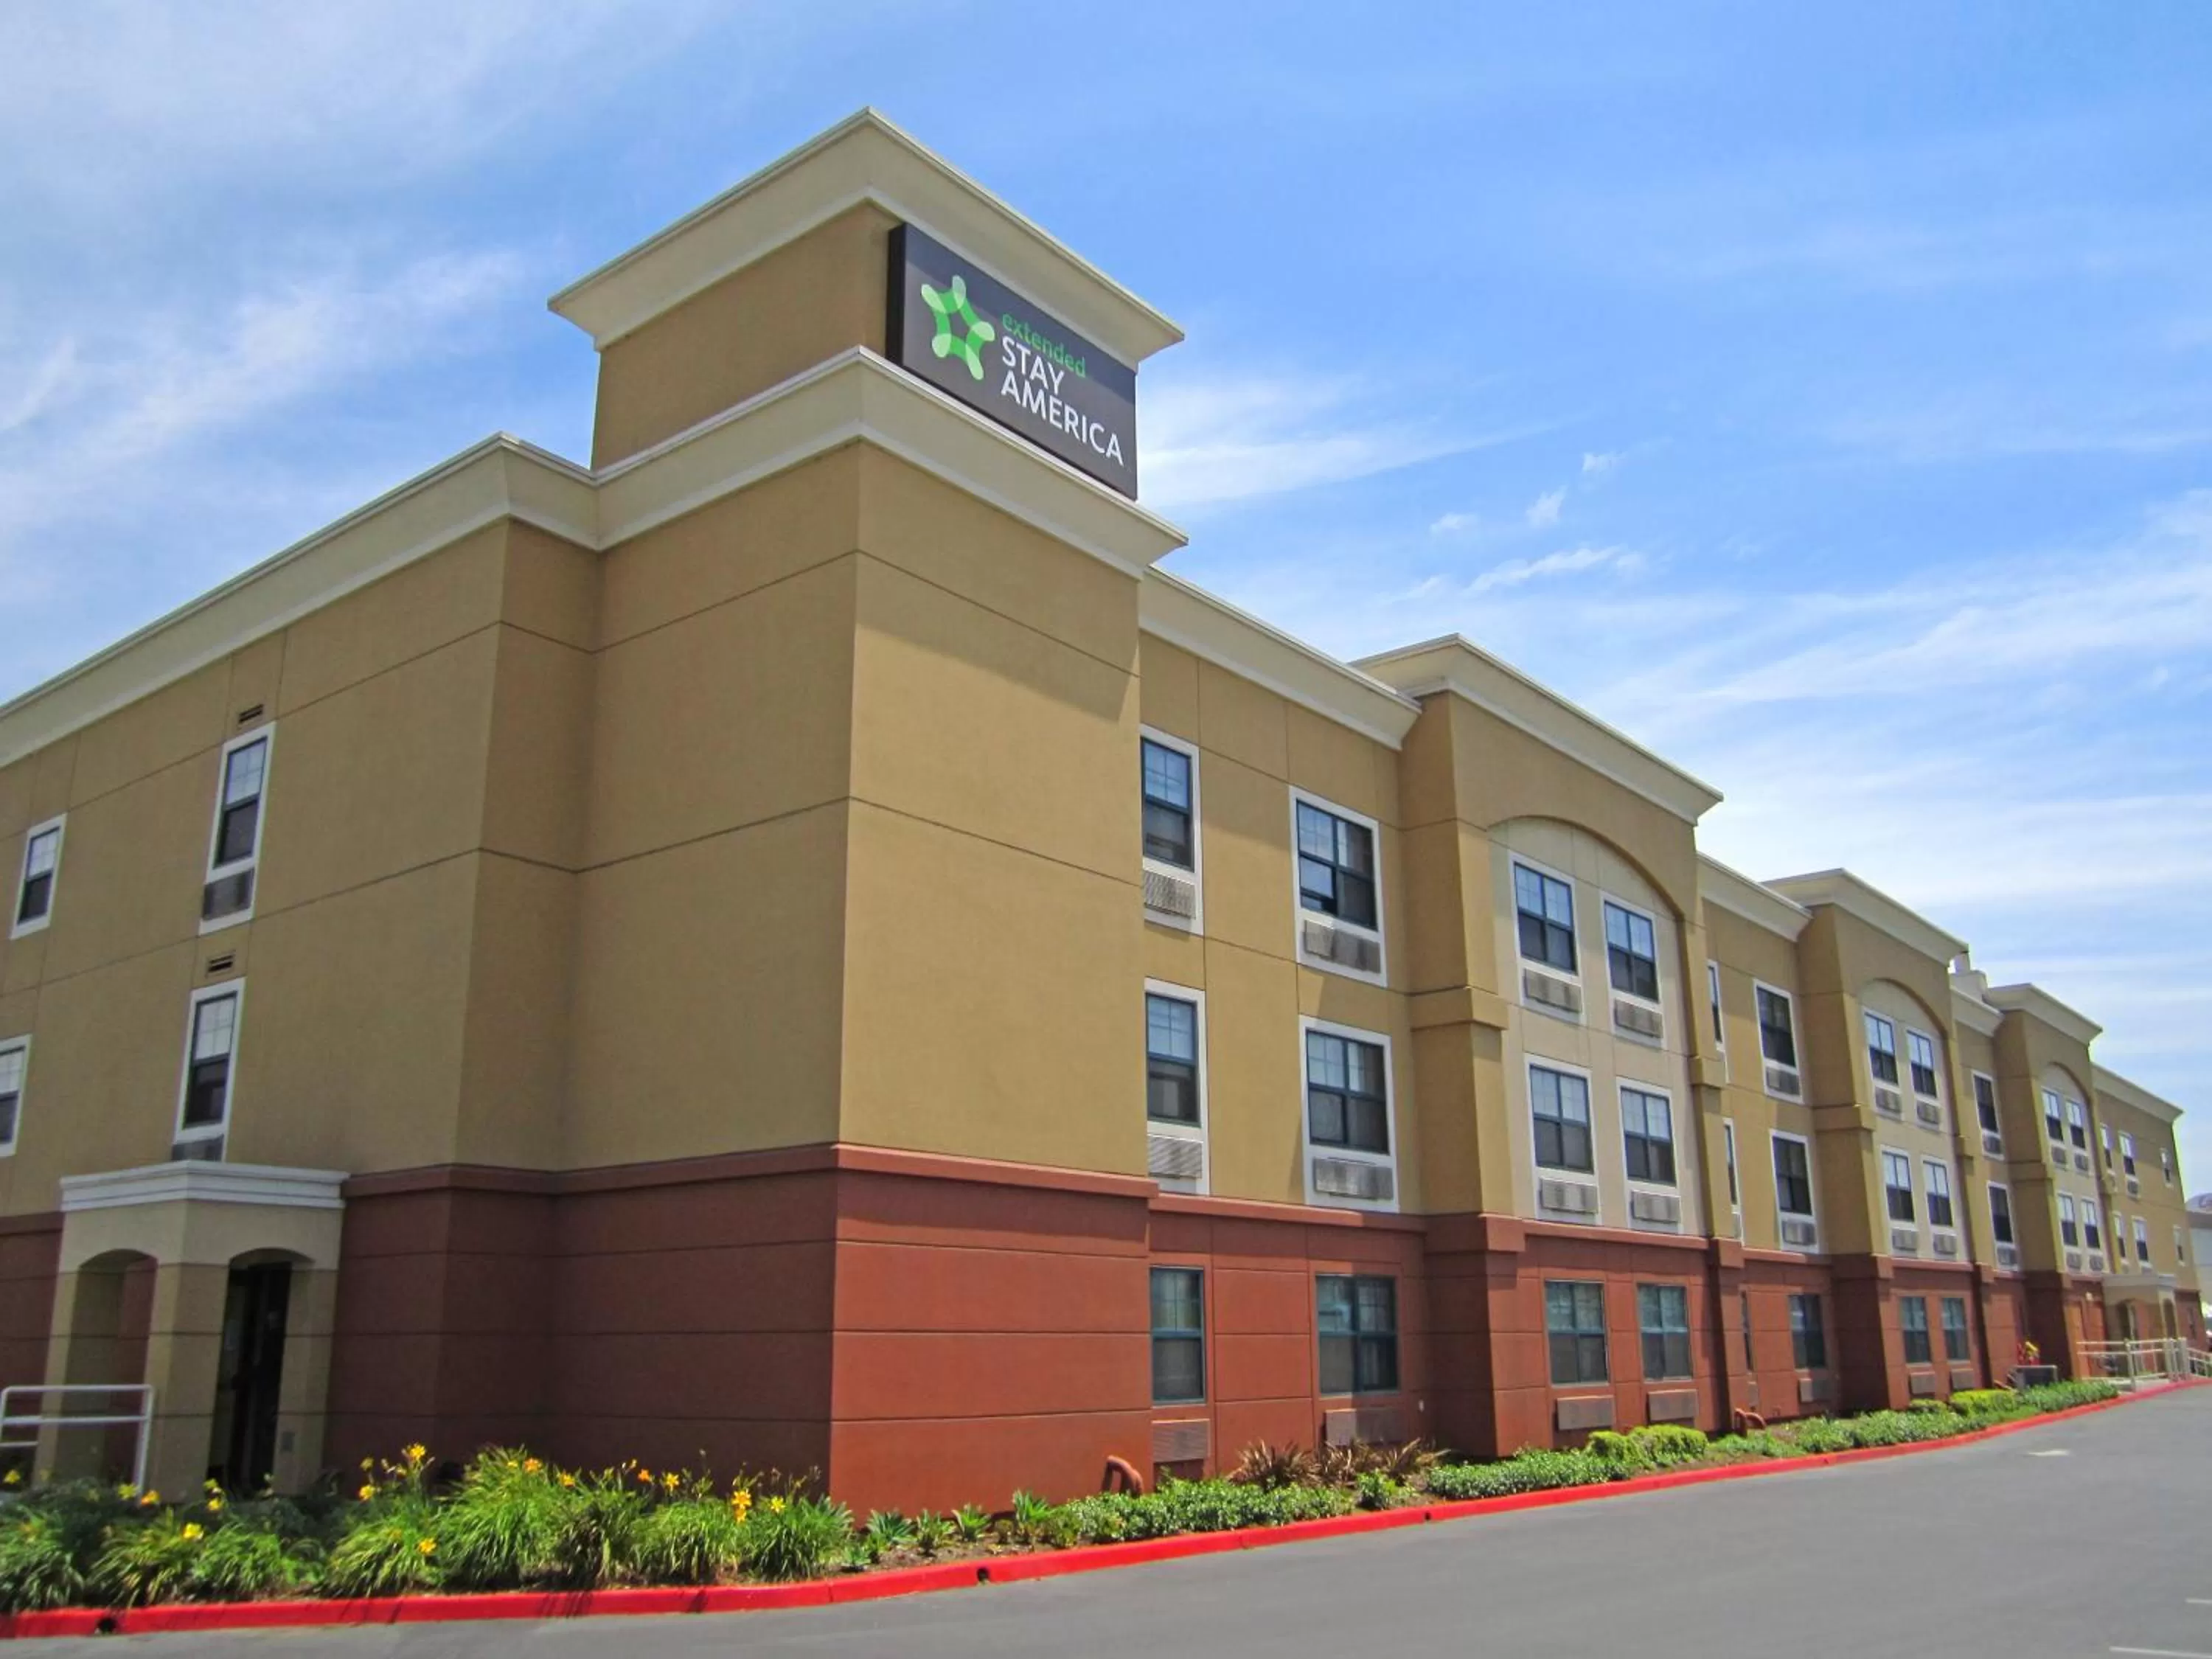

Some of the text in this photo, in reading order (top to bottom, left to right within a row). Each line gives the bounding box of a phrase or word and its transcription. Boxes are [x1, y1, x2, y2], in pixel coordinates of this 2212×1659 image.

[1002, 336, 1064, 394] STAY
[1003, 313, 1087, 378] extended
[1001, 371, 1124, 466] AMERICA
